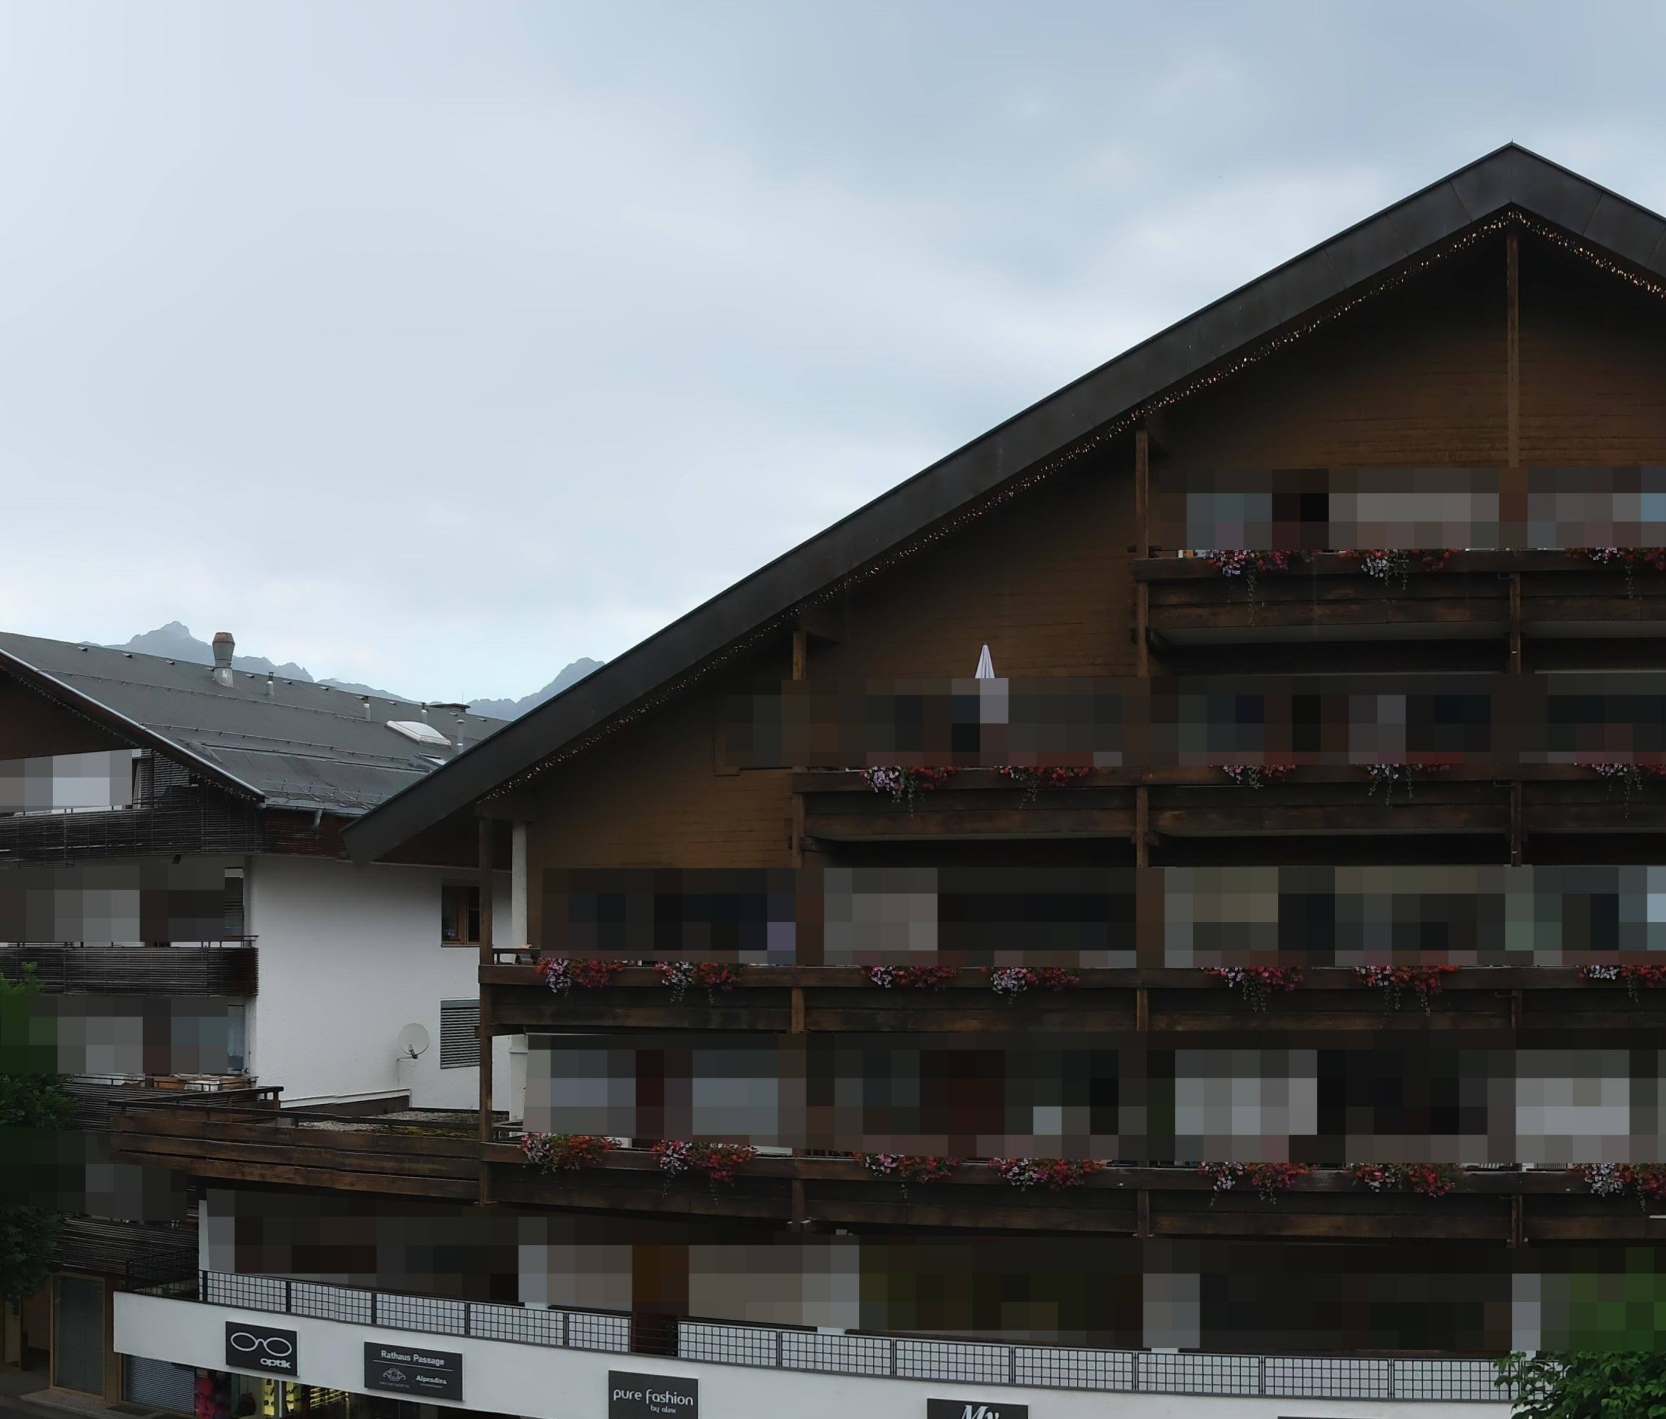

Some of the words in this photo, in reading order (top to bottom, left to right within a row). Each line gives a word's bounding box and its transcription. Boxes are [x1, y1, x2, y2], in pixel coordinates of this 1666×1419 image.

[259, 1357, 292, 1370] optik
[381, 1350, 411, 1362] Rathaus
[412, 1353, 445, 1367] Passage
[613, 1388, 642, 1401] pure
[645, 1388, 694, 1406] fashion
